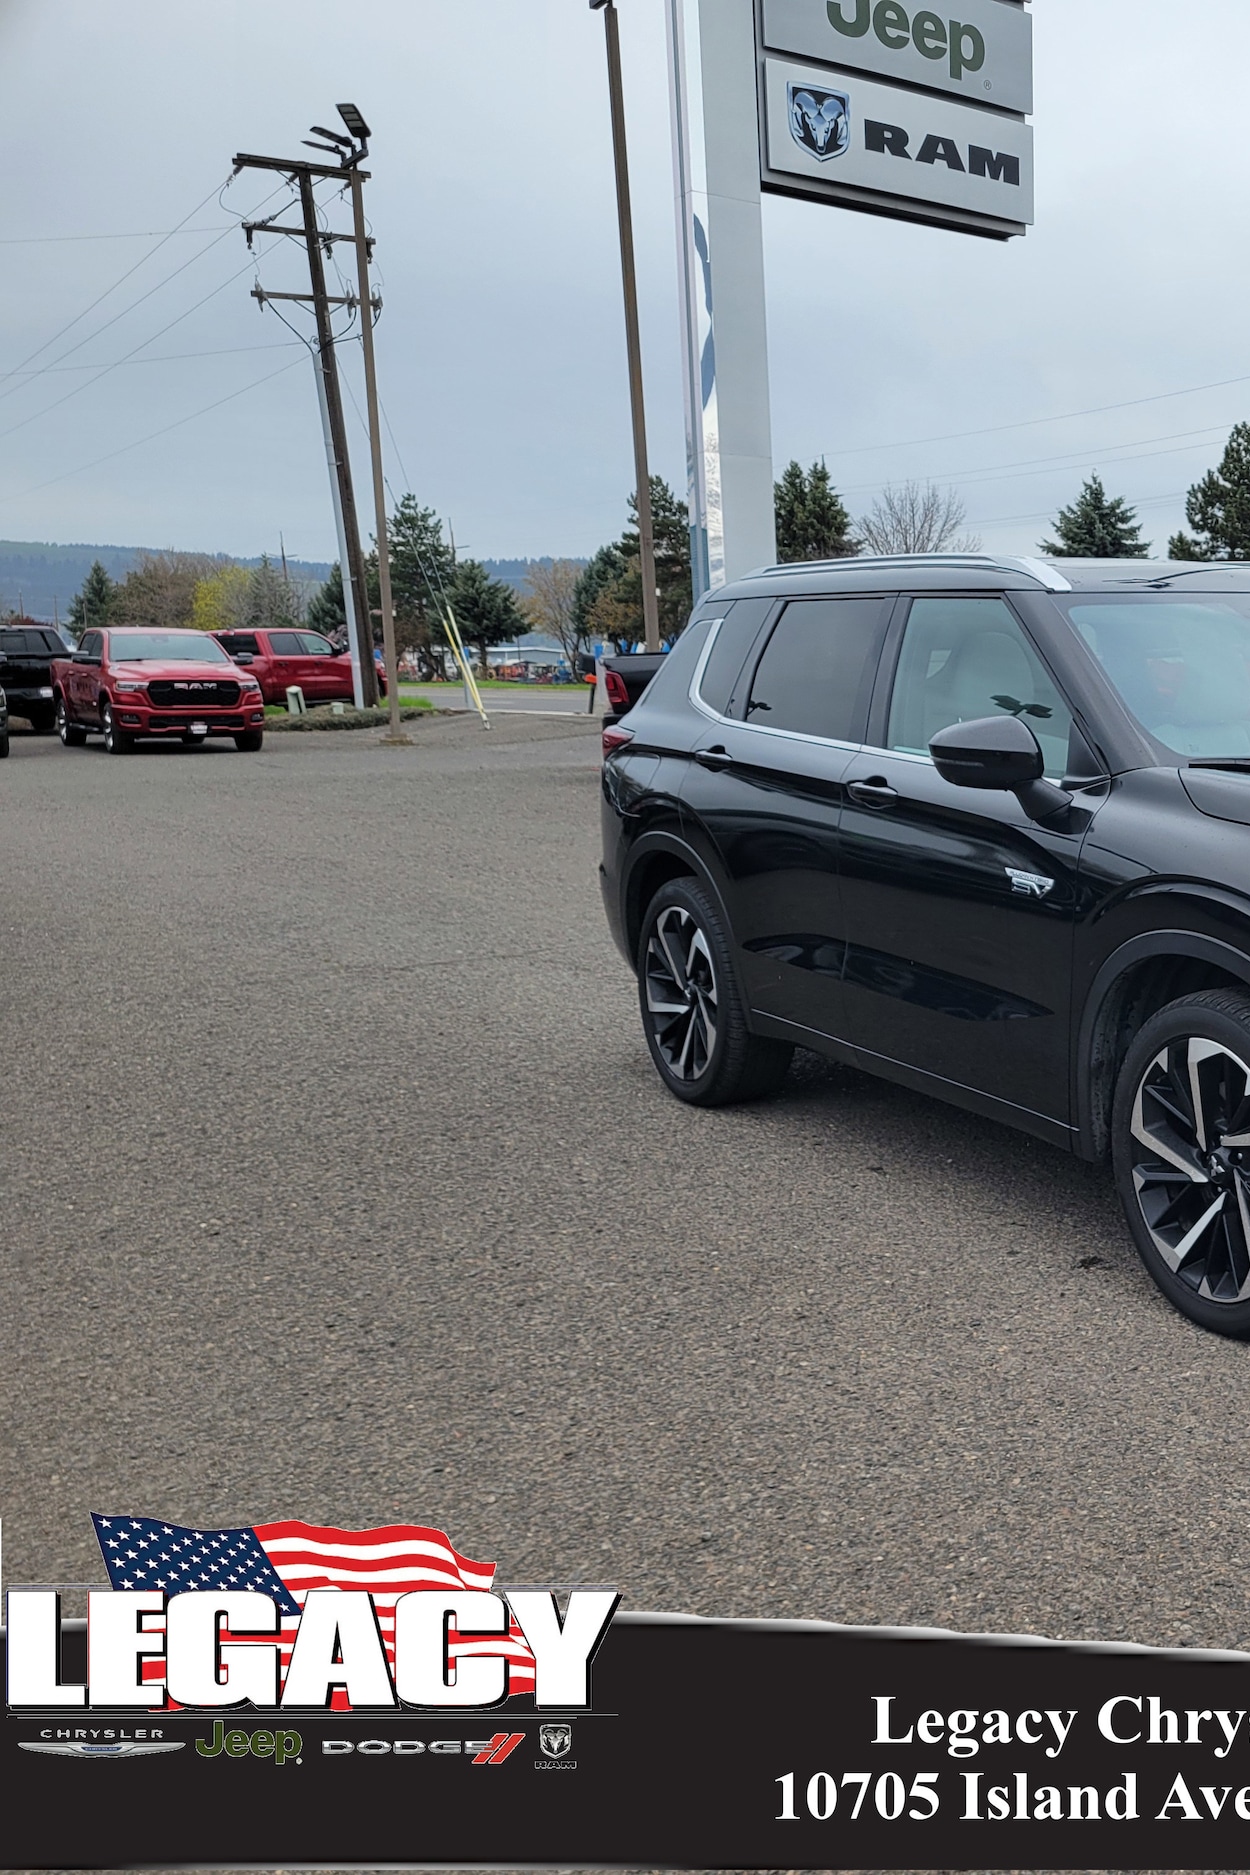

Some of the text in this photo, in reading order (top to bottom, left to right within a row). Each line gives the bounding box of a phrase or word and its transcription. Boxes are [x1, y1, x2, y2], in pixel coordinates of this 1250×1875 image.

[827, 0, 985, 80] Jeep
[864, 119, 1020, 186] RAM
[173, 682, 218, 691] RAM
